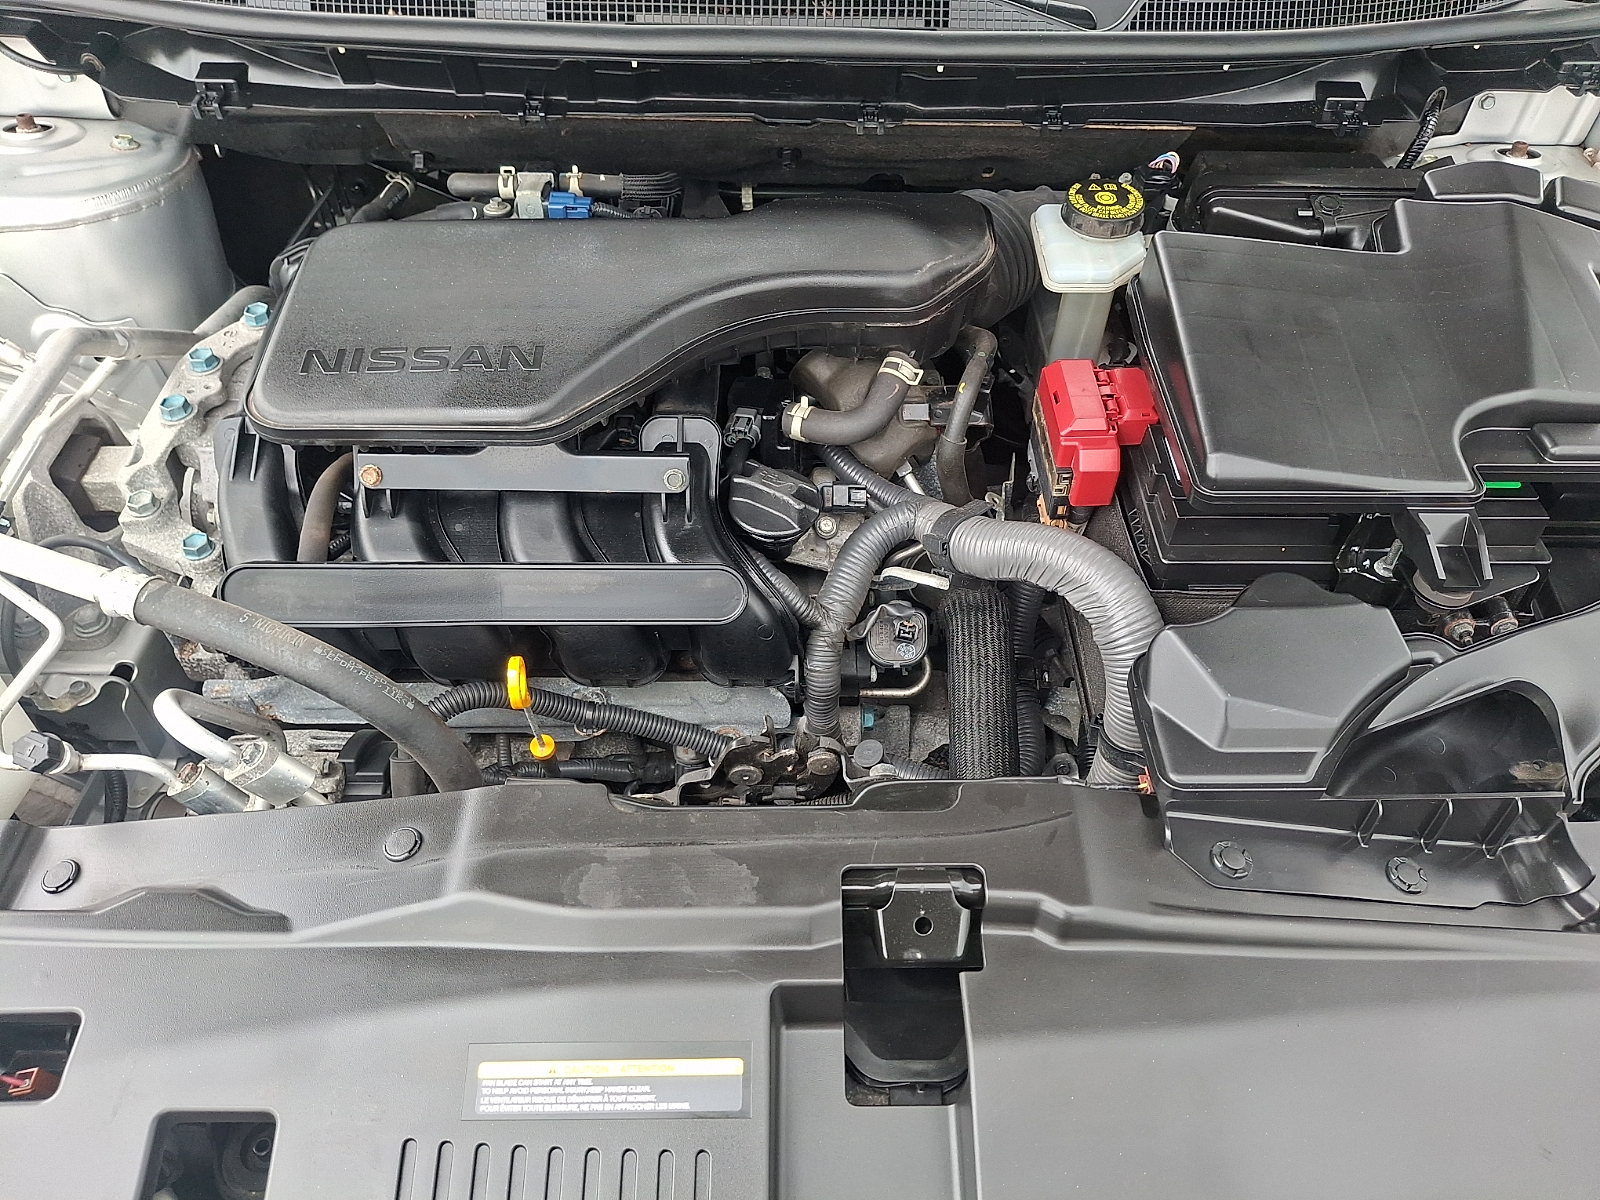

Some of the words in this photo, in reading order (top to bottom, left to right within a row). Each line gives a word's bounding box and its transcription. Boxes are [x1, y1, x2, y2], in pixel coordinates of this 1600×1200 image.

[299, 345, 546, 375] NISSAN
[252, 617, 308, 648] NICHIRIN
[564, 1065, 609, 1074] CAUTION
[620, 1063, 675, 1073] ATTENTION
[482, 1087, 492, 1095] TO
[492, 1087, 509, 1095] HELP
